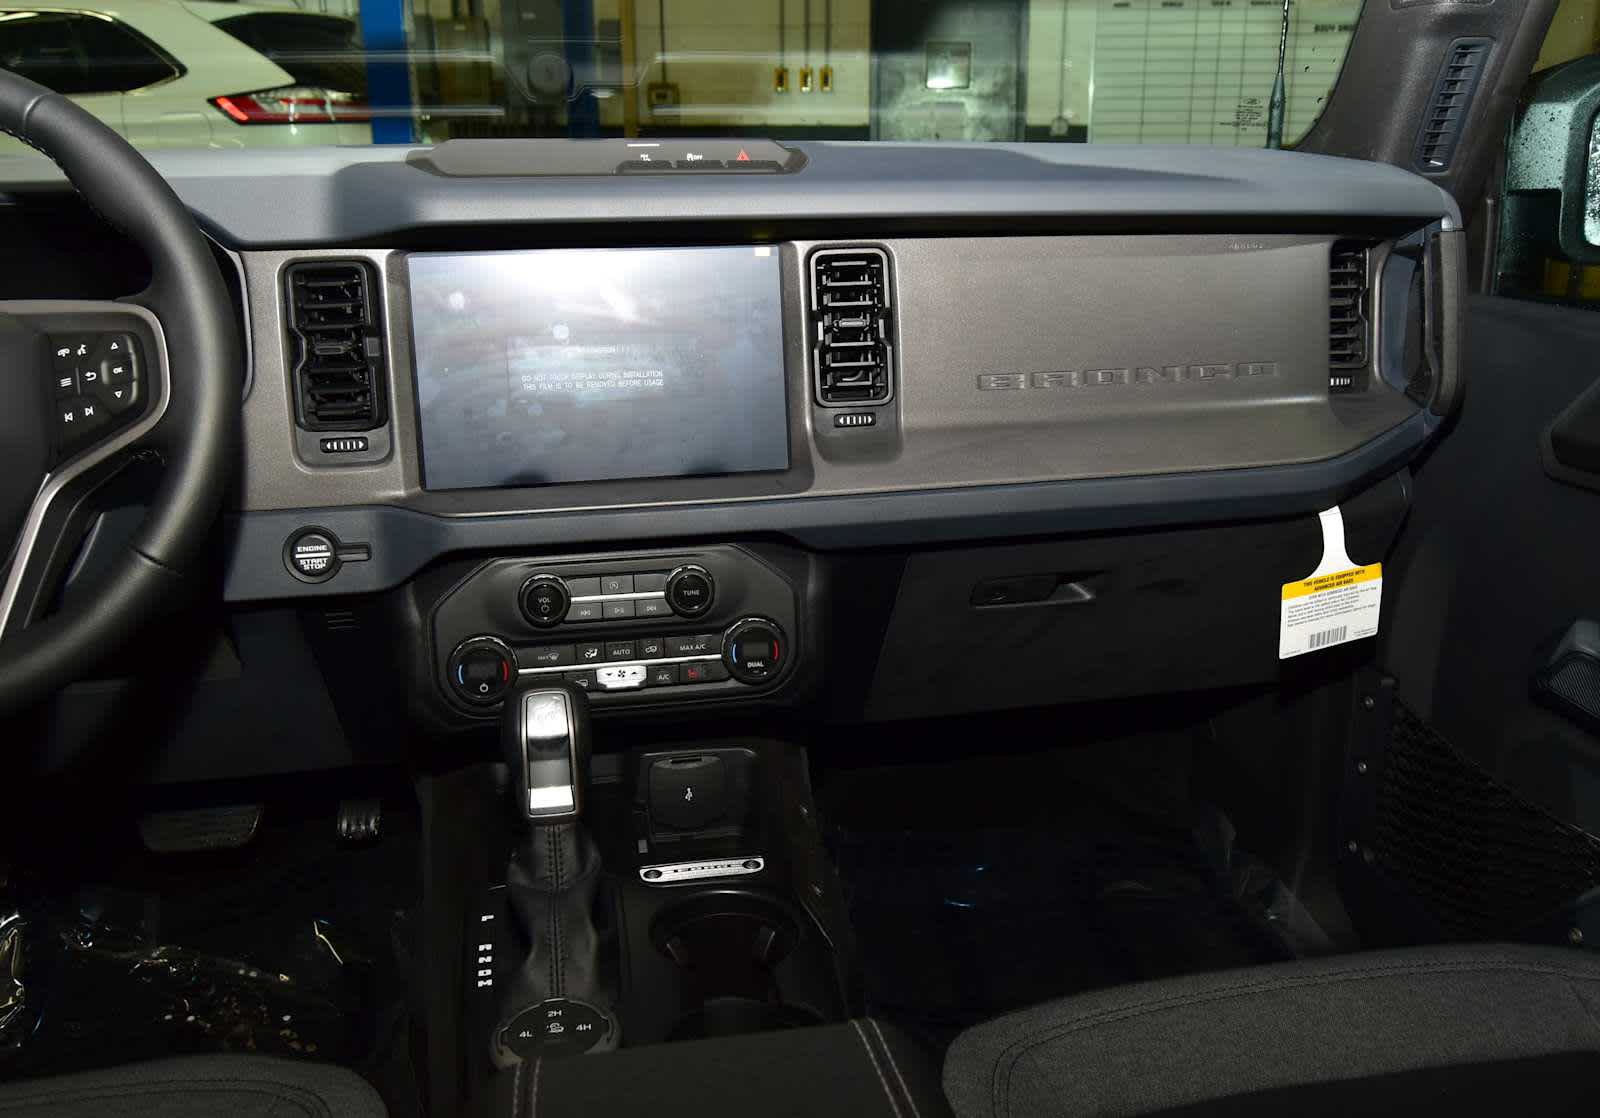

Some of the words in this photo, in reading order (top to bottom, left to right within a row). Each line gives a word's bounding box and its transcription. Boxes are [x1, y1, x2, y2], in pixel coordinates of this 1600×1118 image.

[977, 361, 1278, 391] BRONCO
[612, 648, 631, 656] AUTO
[747, 661, 764, 669] DUAL
[658, 673, 670, 681] A/C
[478, 955, 493, 964] N
[478, 969, 492, 977] D
[477, 979, 493, 988] M
[547, 1009, 562, 1017] 2H
[576, 1023, 592, 1031] 4H
[519, 1030, 533, 1038] 4L
